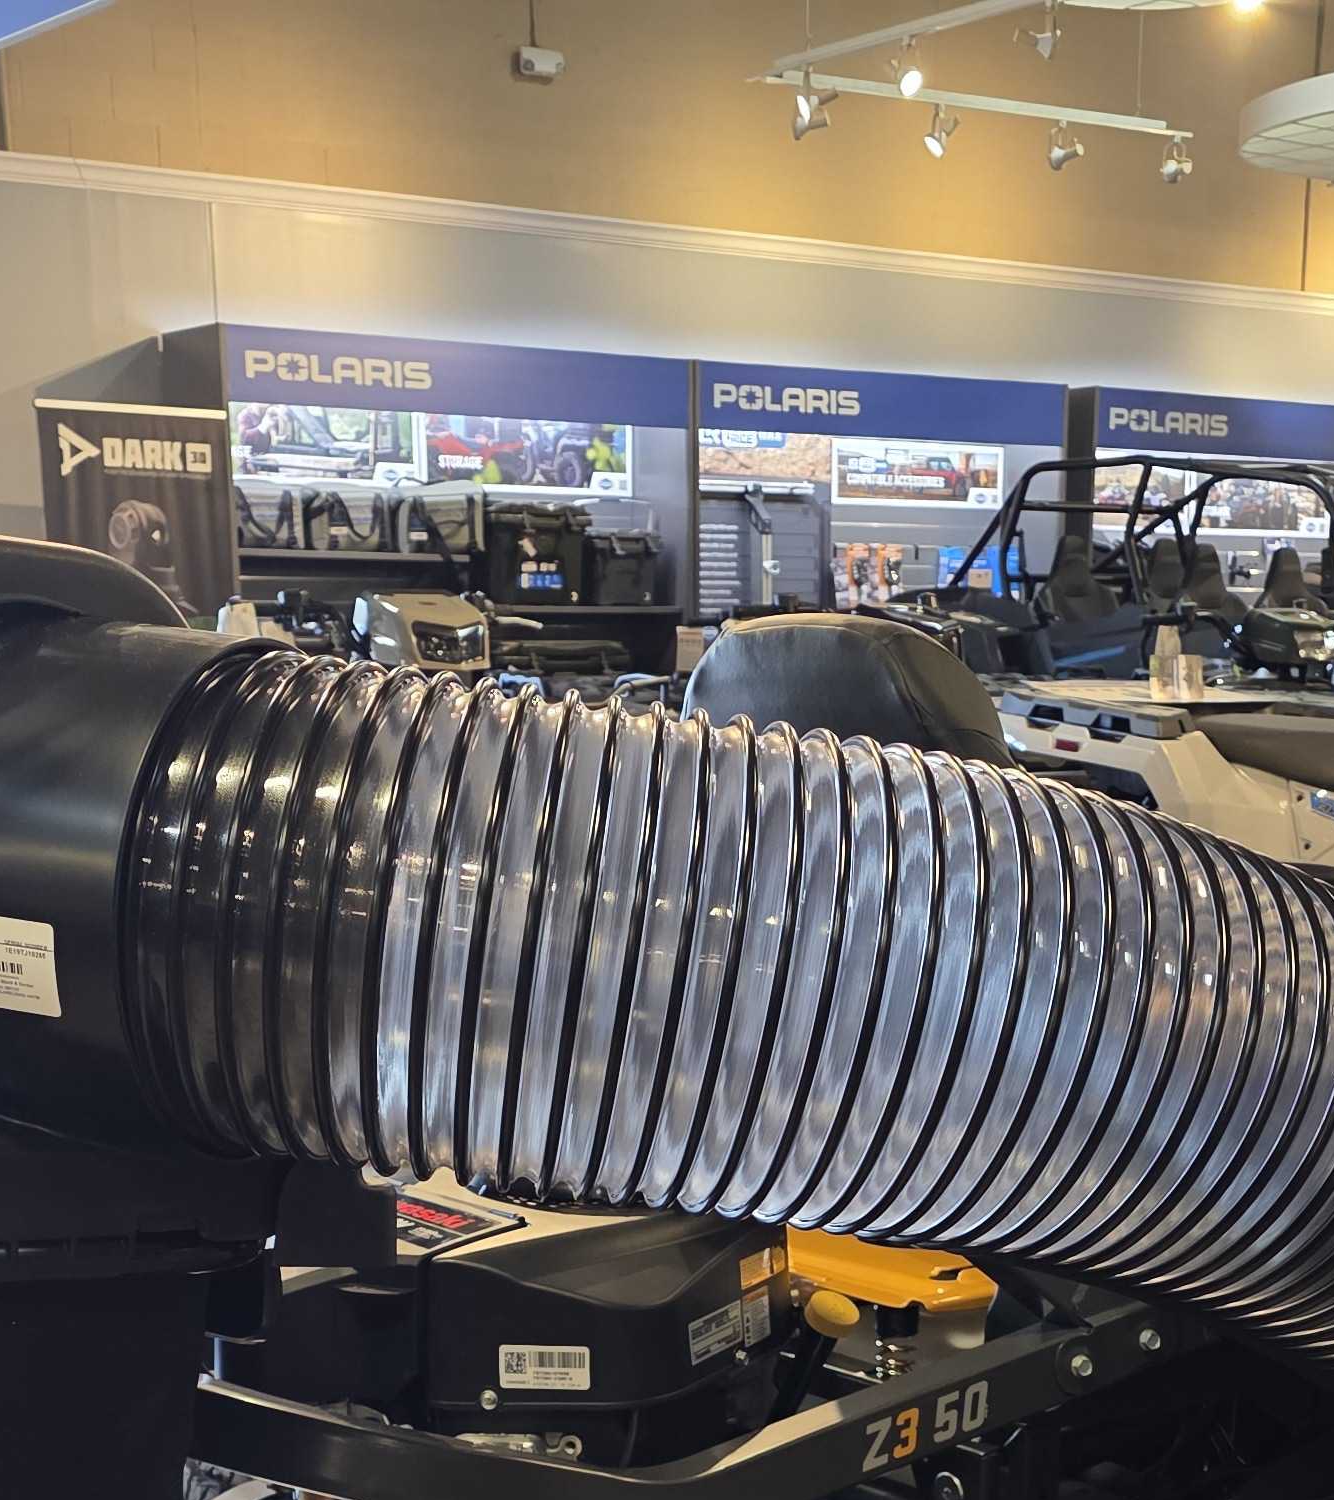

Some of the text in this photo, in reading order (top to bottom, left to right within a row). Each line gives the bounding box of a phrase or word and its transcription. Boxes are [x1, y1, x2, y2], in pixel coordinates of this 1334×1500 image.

[244, 349, 432, 390] POLARIS
[713, 383, 861, 416] POLARIS
[1109, 406, 1229, 438] POLARIS
[102, 437, 183, 471] DARK
[862, 1380, 989, 1473] Z3 50
